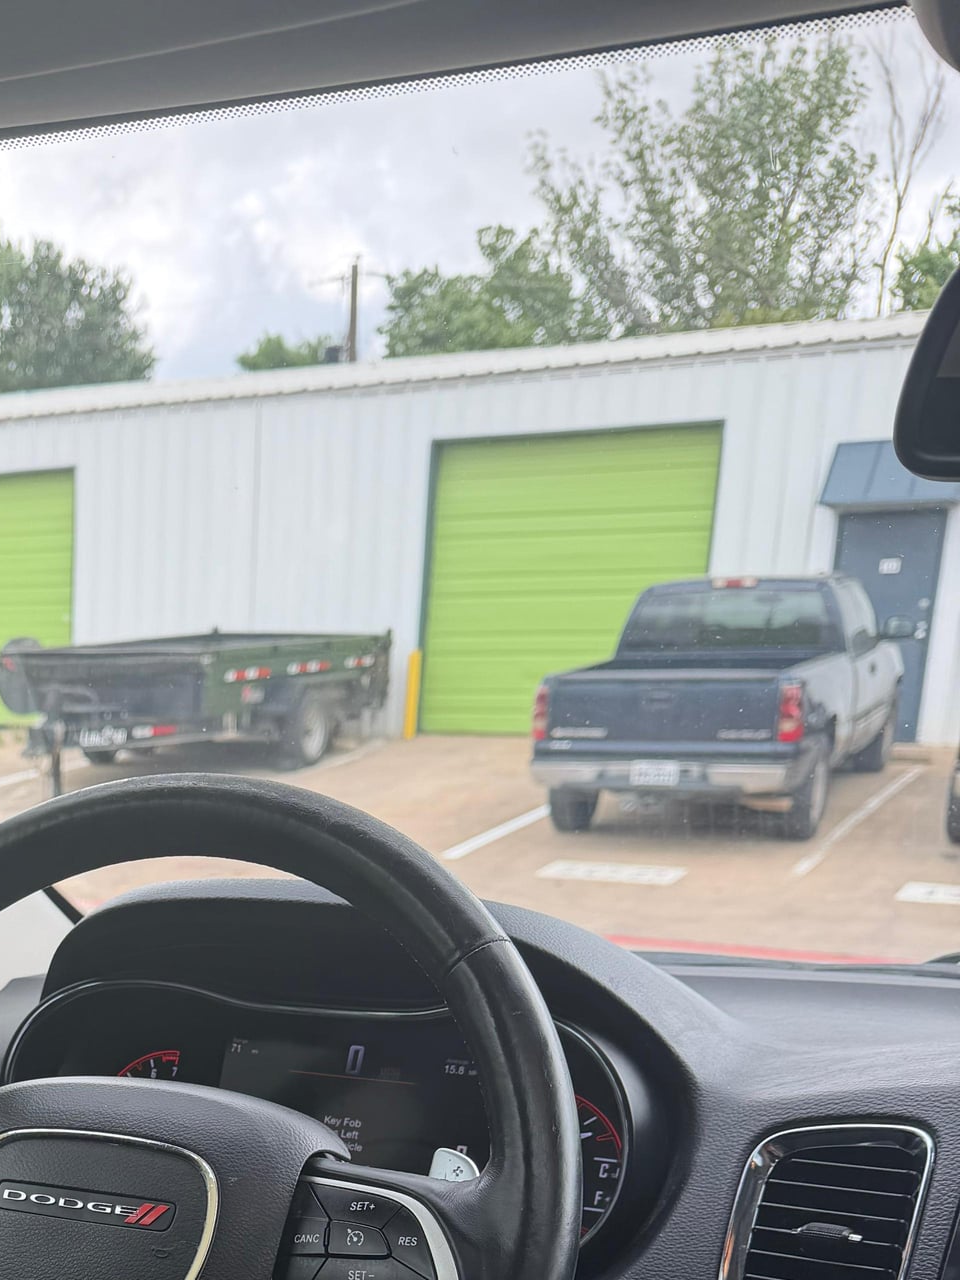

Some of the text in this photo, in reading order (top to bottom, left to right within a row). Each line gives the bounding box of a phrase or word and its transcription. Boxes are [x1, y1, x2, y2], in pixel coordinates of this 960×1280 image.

[345, 1044, 365, 1075] 0
[150, 1068, 158, 1079] 6
[171, 1066, 178, 1078] 7
[444, 1064, 465, 1076] 15.8
[323, 1115, 362, 1128] Key Fob
[340, 1129, 359, 1140] Left
[598, 1163, 610, 1178] C
[2, 1188, 139, 1218] DODGE
[593, 1190, 604, 1206] F
[294, 1234, 320, 1243] CANC
[397, 1236, 418, 1247] RES
